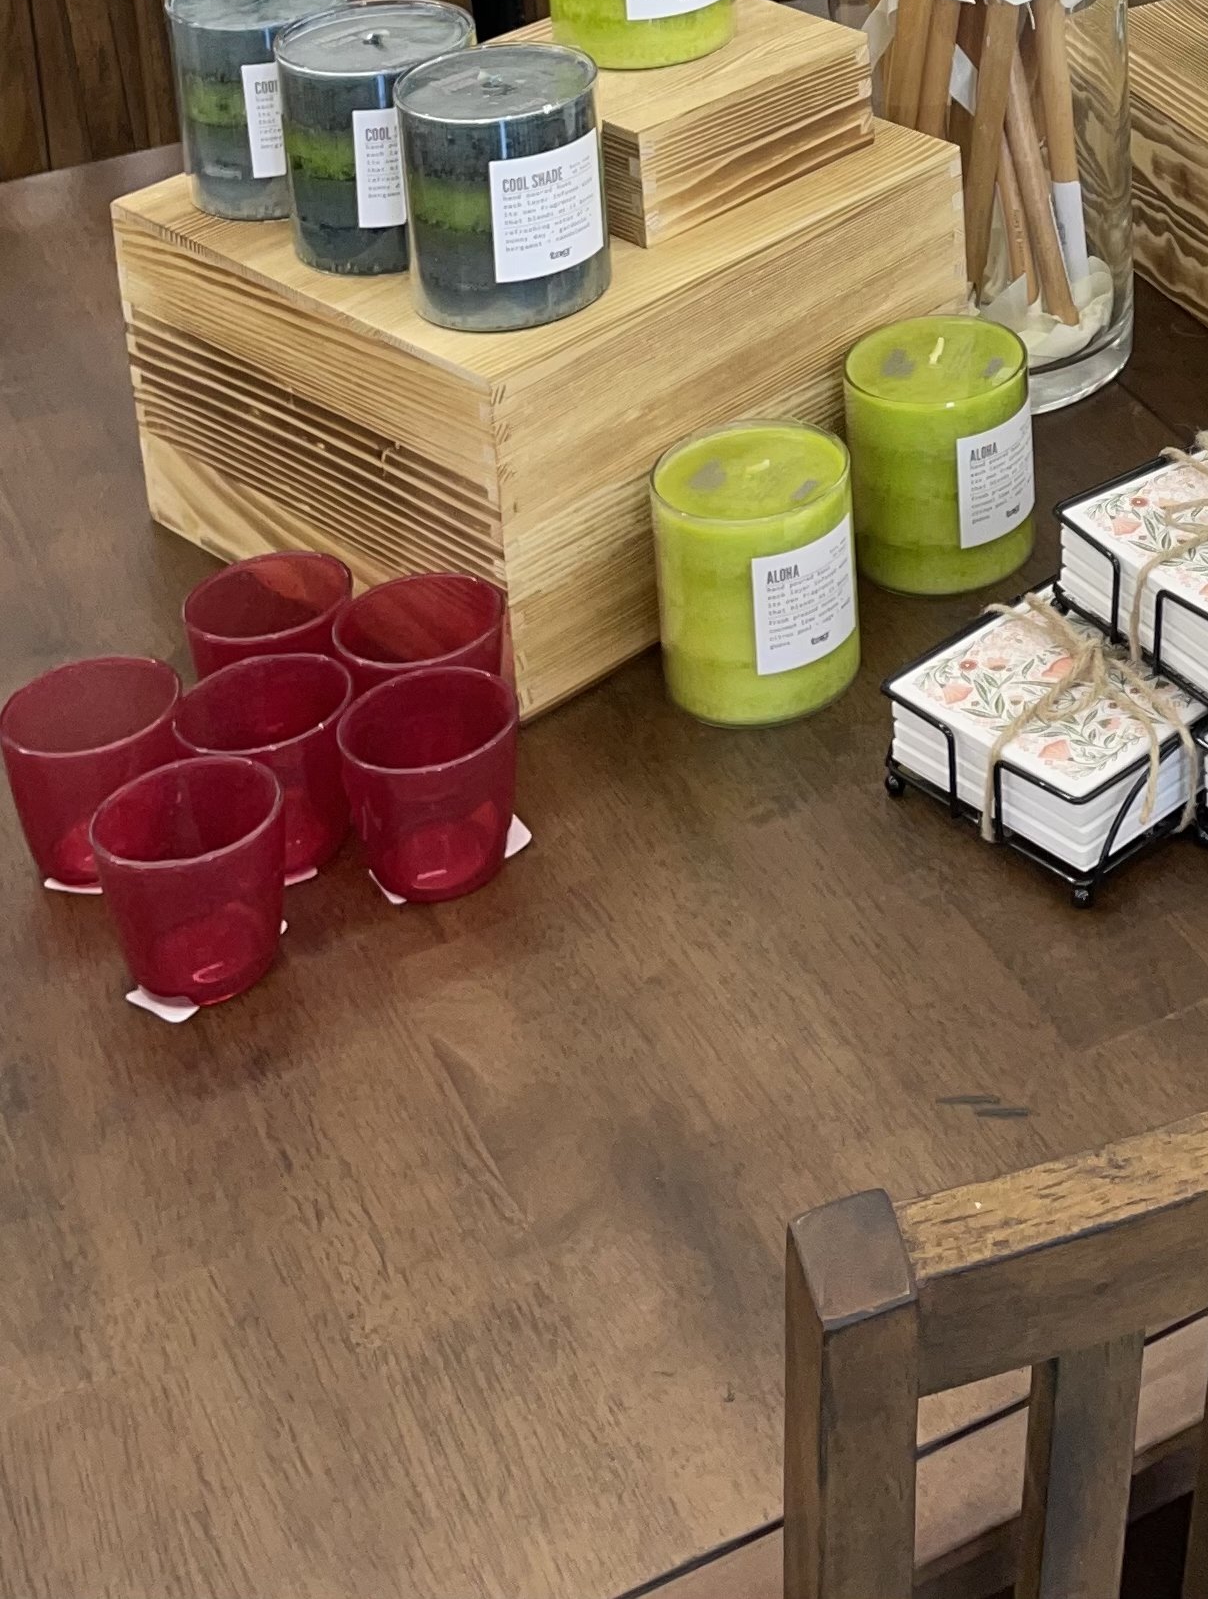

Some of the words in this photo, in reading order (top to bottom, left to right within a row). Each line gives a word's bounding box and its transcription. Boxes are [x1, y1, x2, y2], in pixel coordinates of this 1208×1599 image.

[365, 127, 391, 141] COOL
[502, 177, 529, 193] COOL
[532, 166, 563, 188] SHADE
[971, 442, 997, 461] ALOHA
[767, 565, 799, 584] ALOHA
